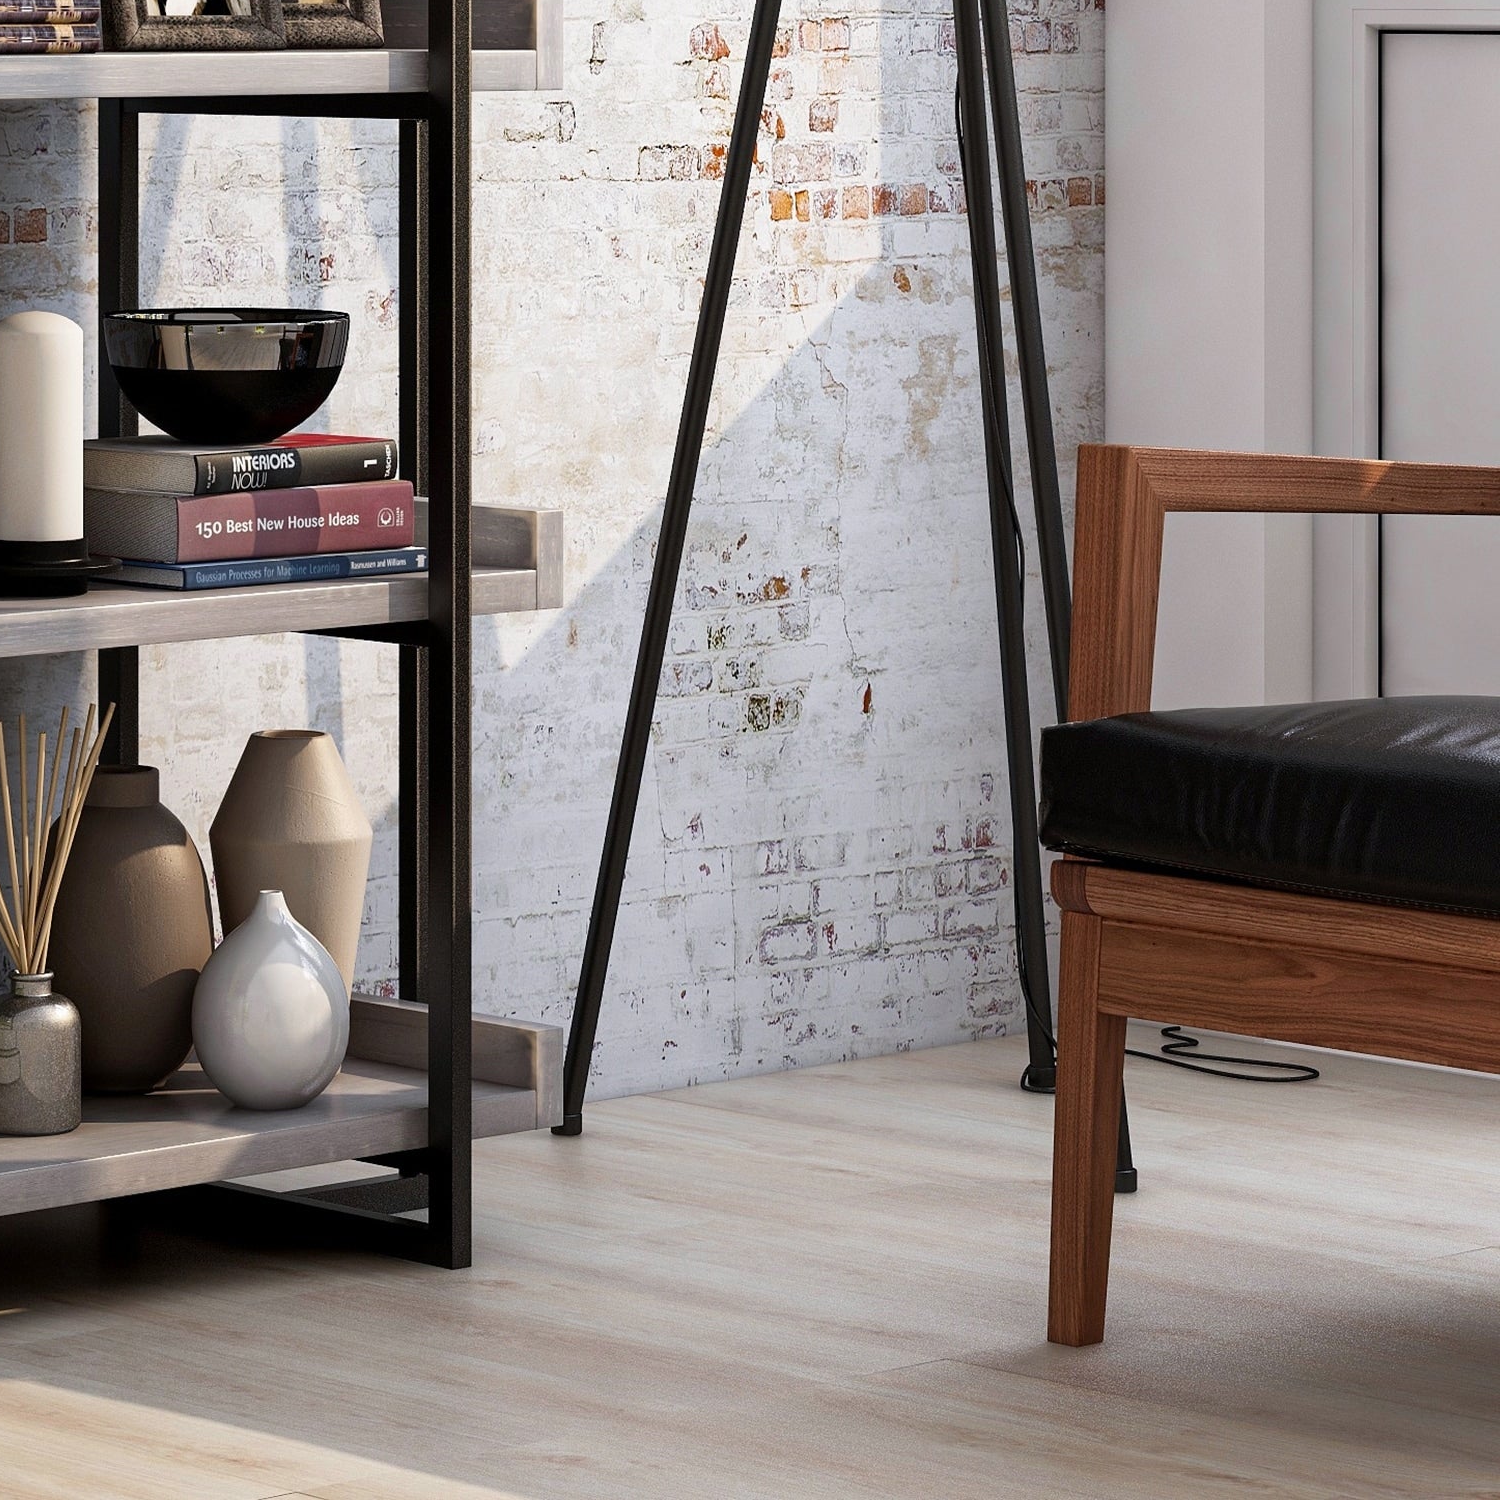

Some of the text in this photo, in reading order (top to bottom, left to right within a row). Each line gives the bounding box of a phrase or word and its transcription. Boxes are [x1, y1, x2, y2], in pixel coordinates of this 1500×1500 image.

[231, 451, 296, 472] INTERIORS
[363, 458, 379, 469] 1
[231, 471, 268, 491] NOW!
[196, 511, 360, 538] 150 Best New House Ideas
[196, 562, 340, 583] Gaussian Processes for Machine Learning
[377, 559, 386, 568] and
